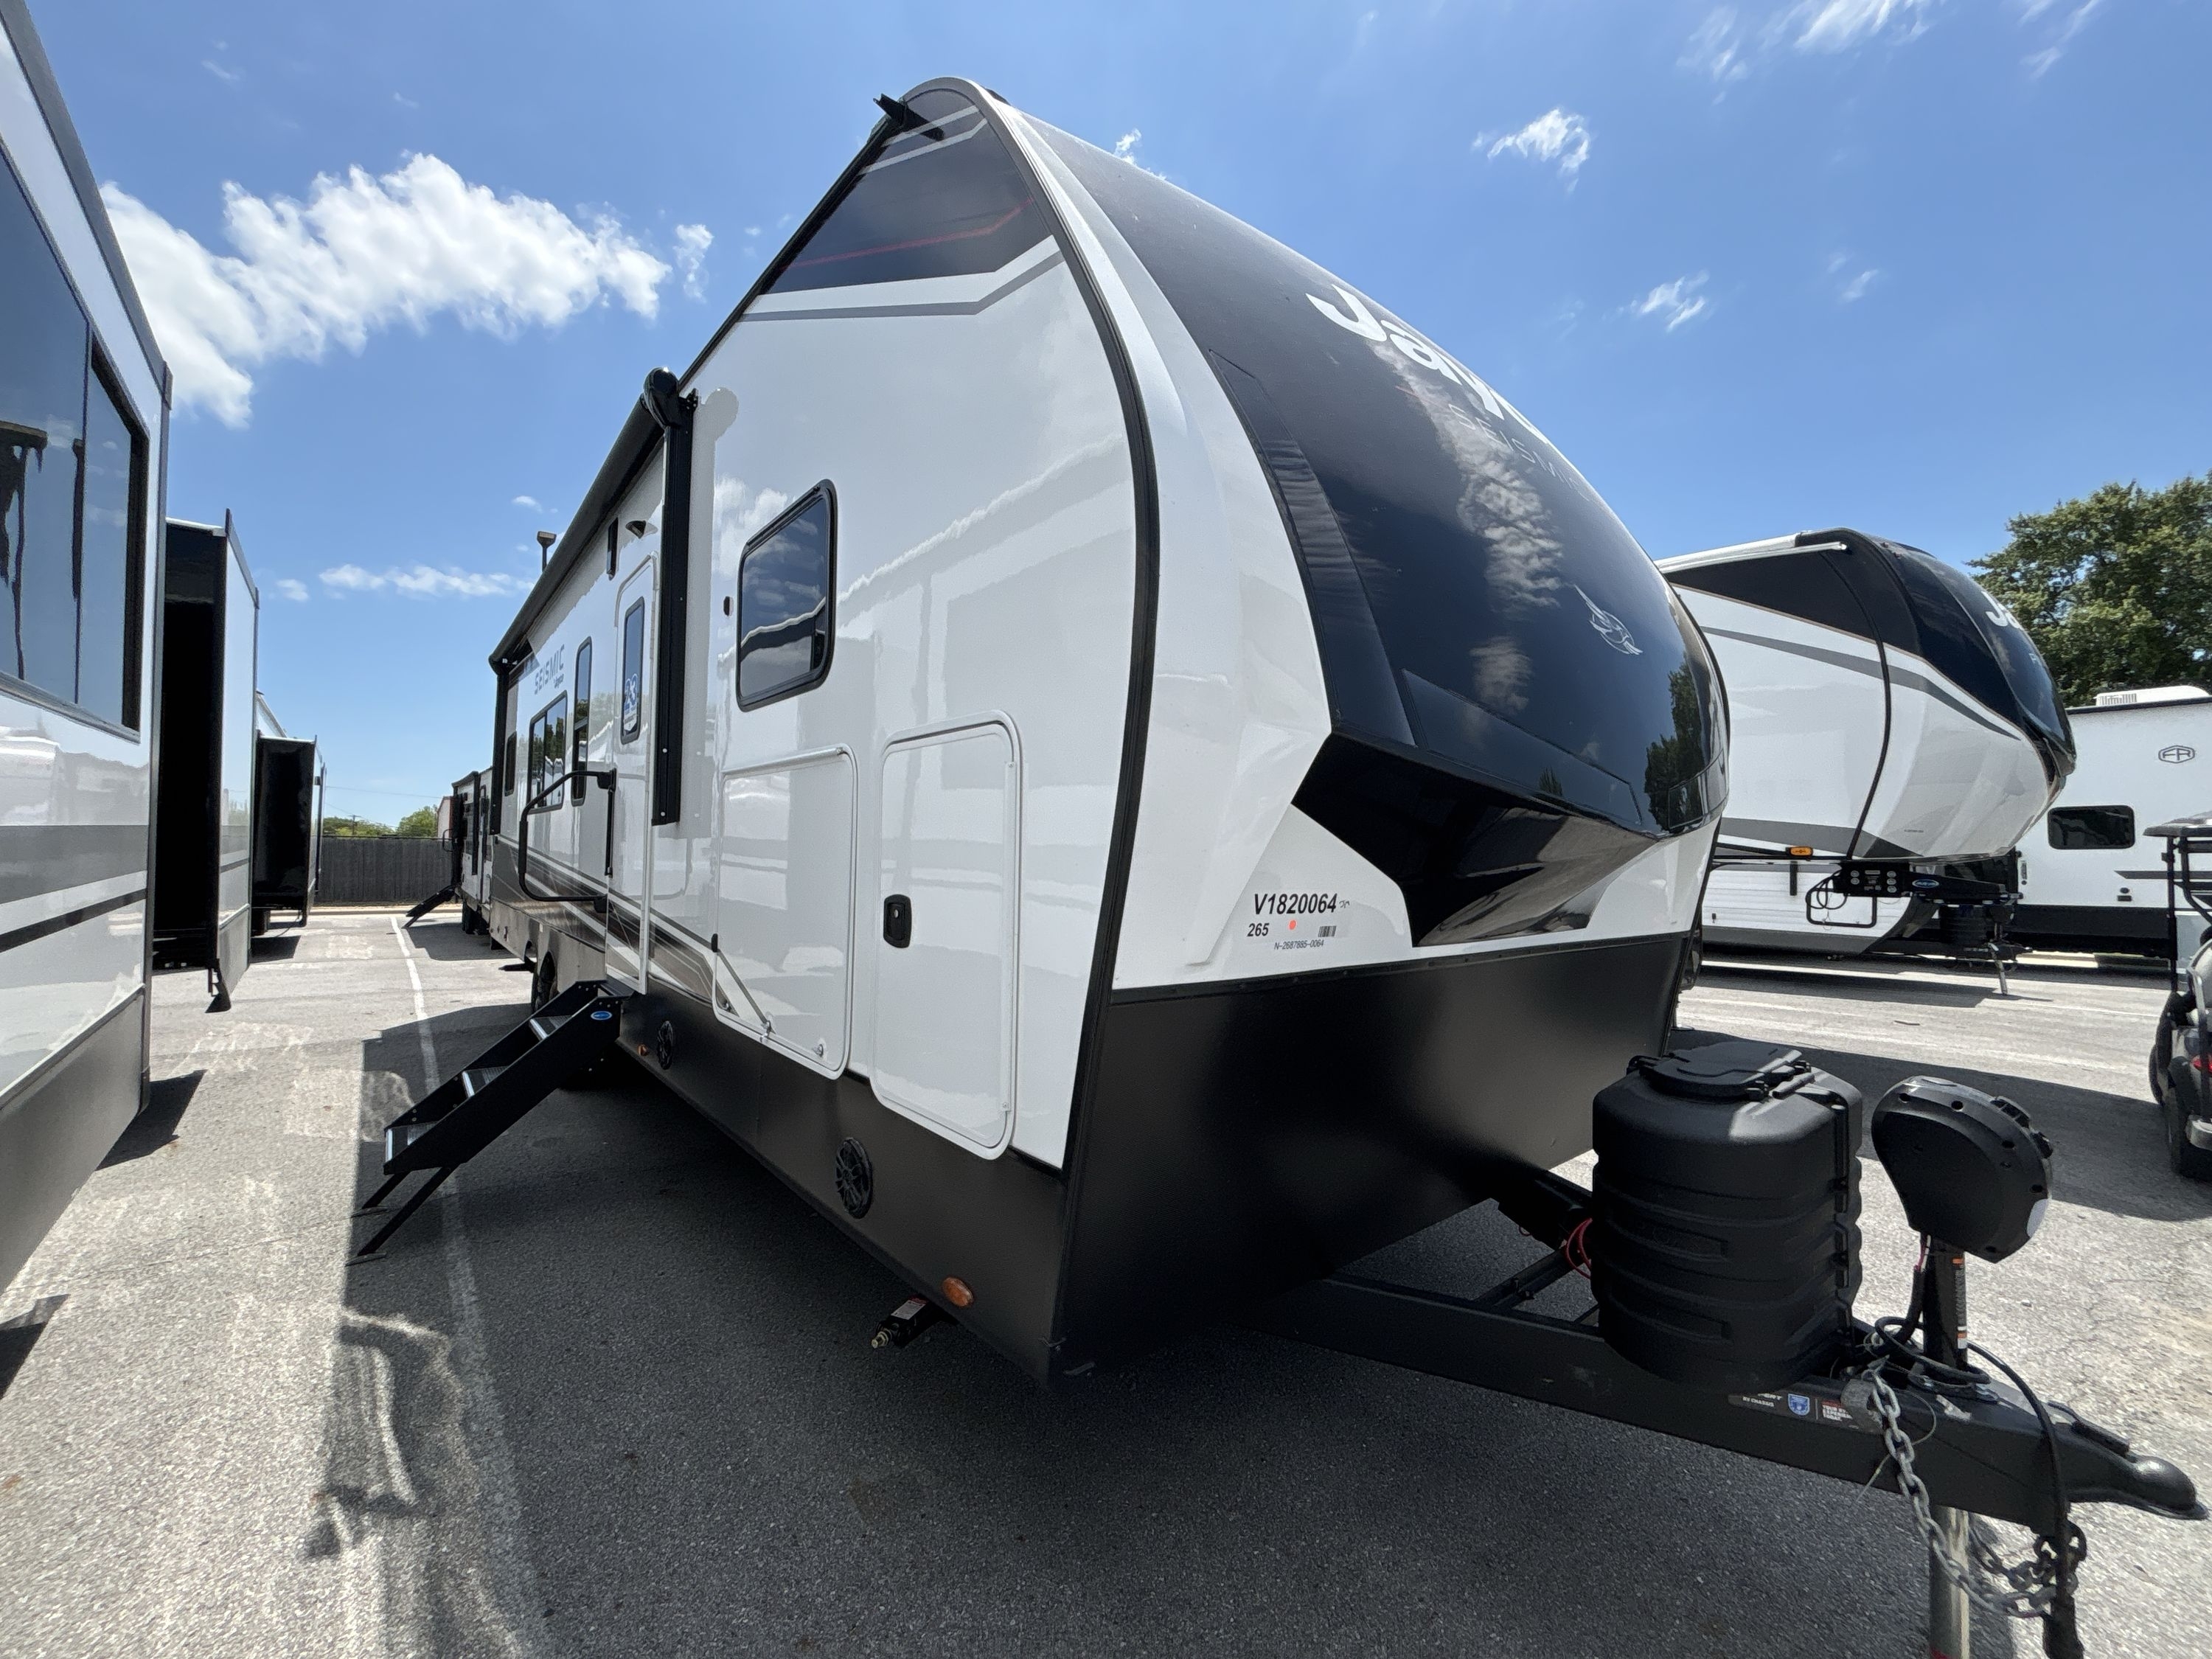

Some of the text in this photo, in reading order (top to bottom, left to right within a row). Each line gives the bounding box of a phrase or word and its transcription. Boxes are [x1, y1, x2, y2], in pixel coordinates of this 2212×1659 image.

[535, 644, 565, 695] SEISMIC
[1254, 893, 1338, 915] V1820064
[1247, 922, 1270, 937] 265
